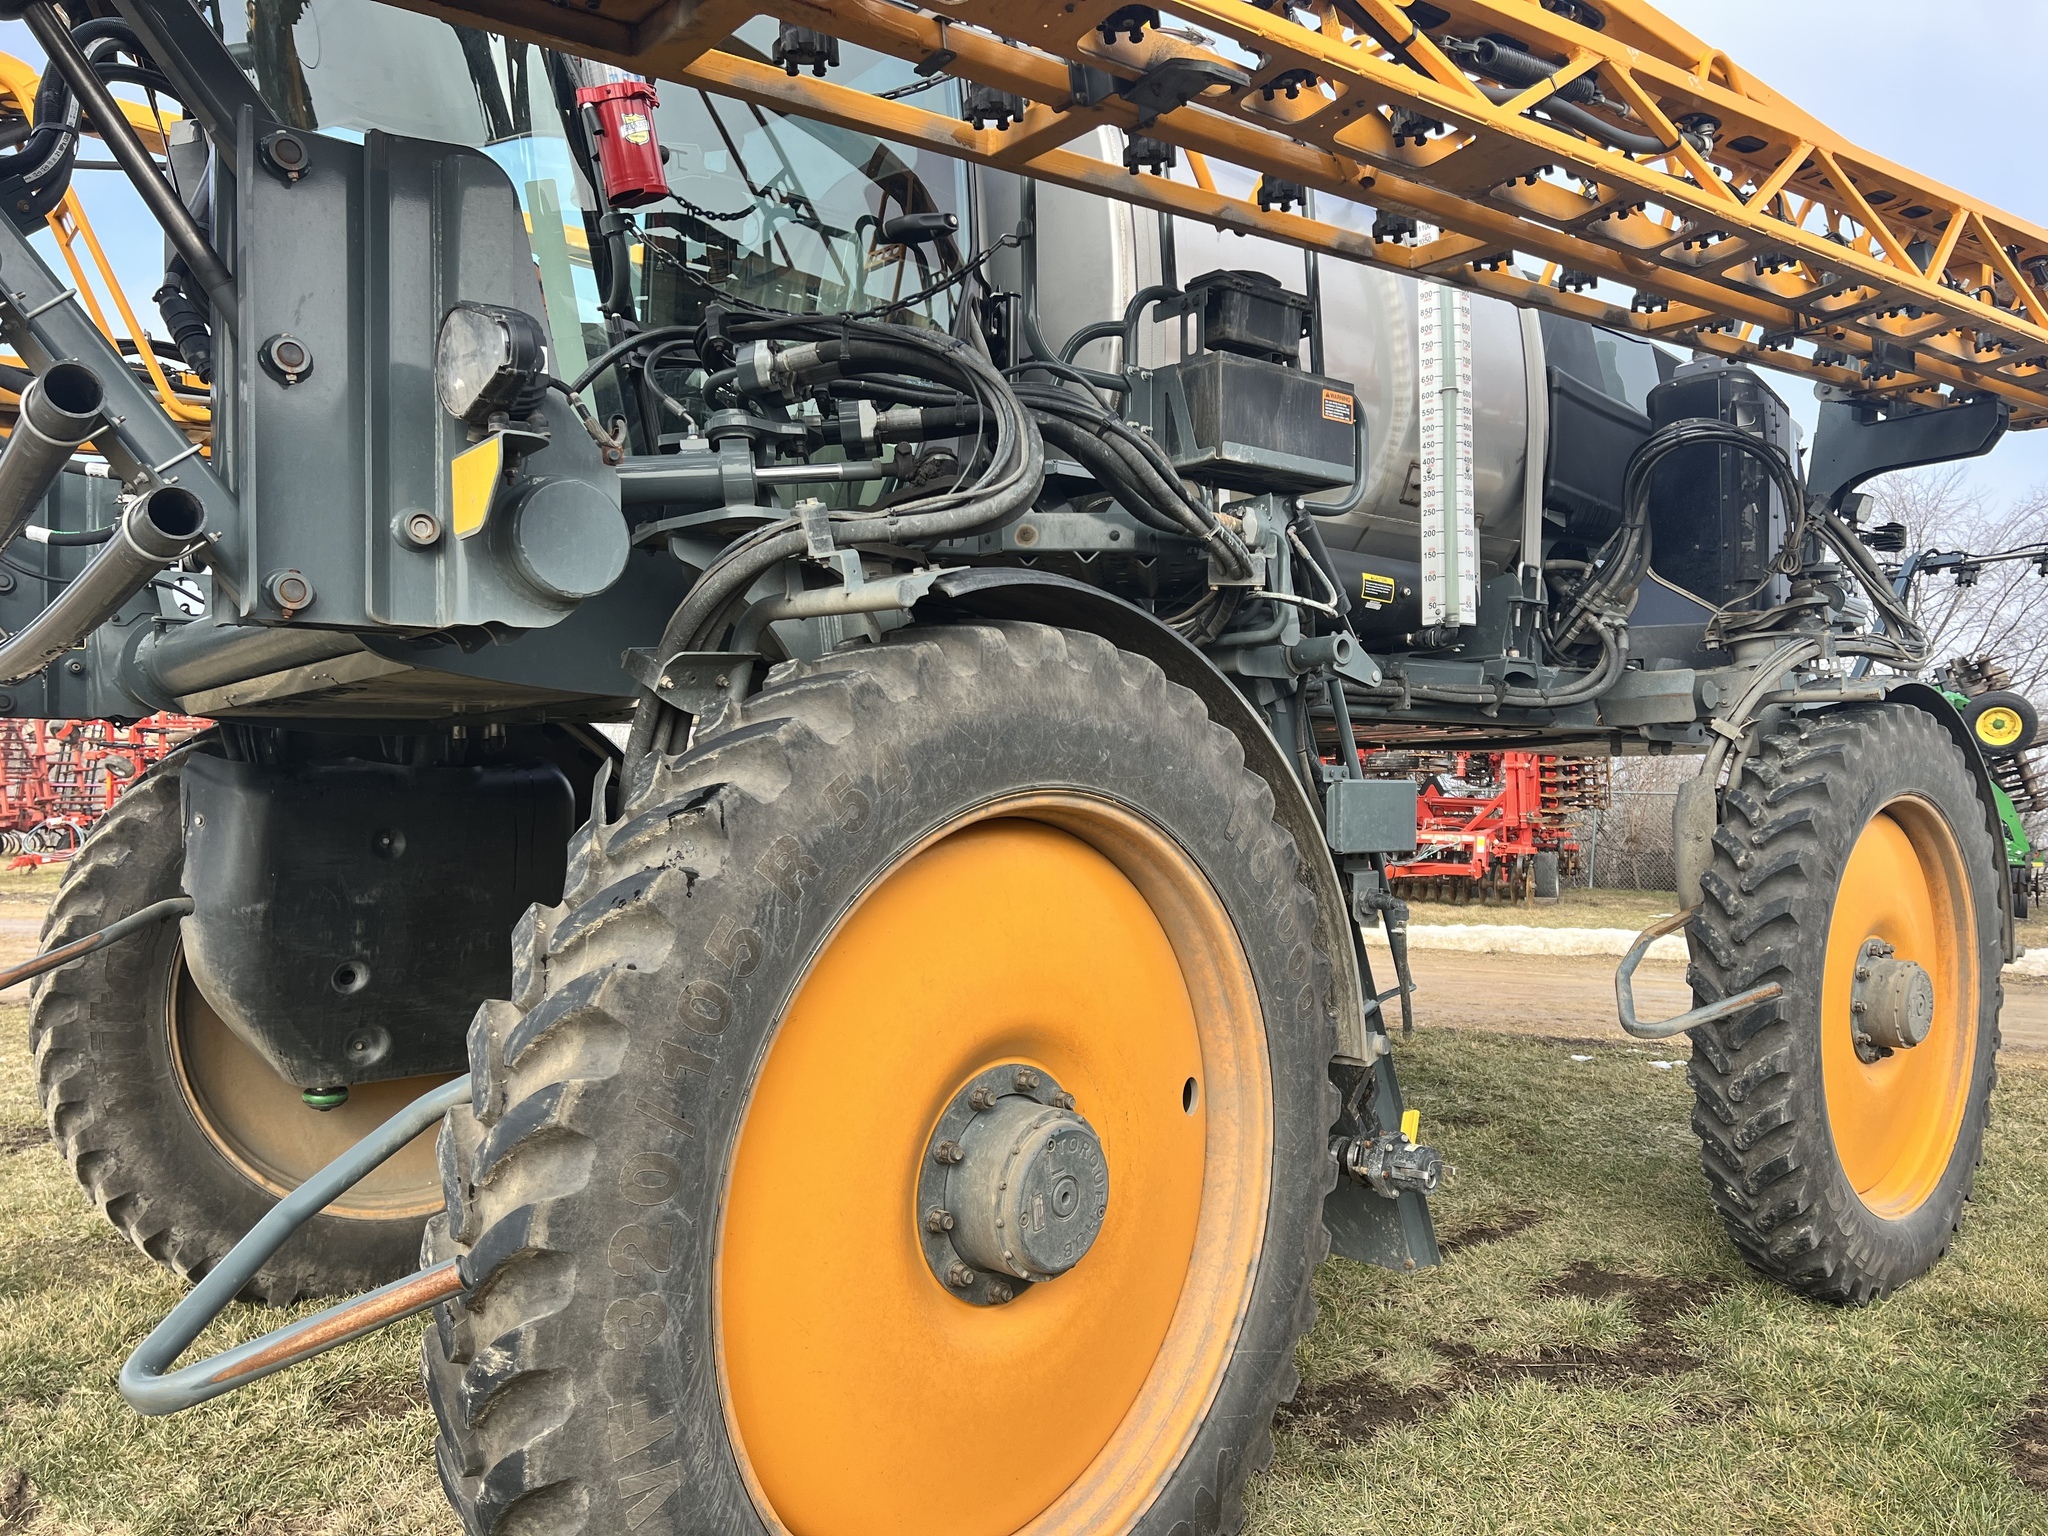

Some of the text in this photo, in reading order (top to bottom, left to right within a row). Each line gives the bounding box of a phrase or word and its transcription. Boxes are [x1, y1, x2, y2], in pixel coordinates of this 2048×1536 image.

[1420, 290, 1432, 300] 900
[1420, 307, 1432, 316] 850
[1420, 324, 1433, 333] 800
[1421, 341, 1433, 350] 750
[1421, 358, 1433, 366] 700
[1422, 374, 1434, 383] 650
[1463, 374, 1471, 382] 650
[1330, 394, 1350, 402] WARNING
[1422, 391, 1434, 400] 600
[1463, 390, 1471, 398] 600
[1422, 408, 1434, 416] 550
[1463, 407, 1471, 415] 550
[1422, 424, 1434, 433] 500
[1463, 423, 1471, 431] 500
[1464, 440, 1472, 448] 450
[1422, 457, 1435, 465] 400
[1464, 456, 1472, 464] 400
[1423, 474, 1436, 482] 350
[1423, 490, 1436, 498] 300
[1464, 489, 1472, 497] 300
[1424, 508, 1436, 516] 250
[1424, 530, 1436, 538] 200
[1424, 550, 1436, 559] 150
[1424, 574, 1436, 582] 100
[603, 914, 763, 1350] 320/105
[607, 1399, 687, 1532] VF
